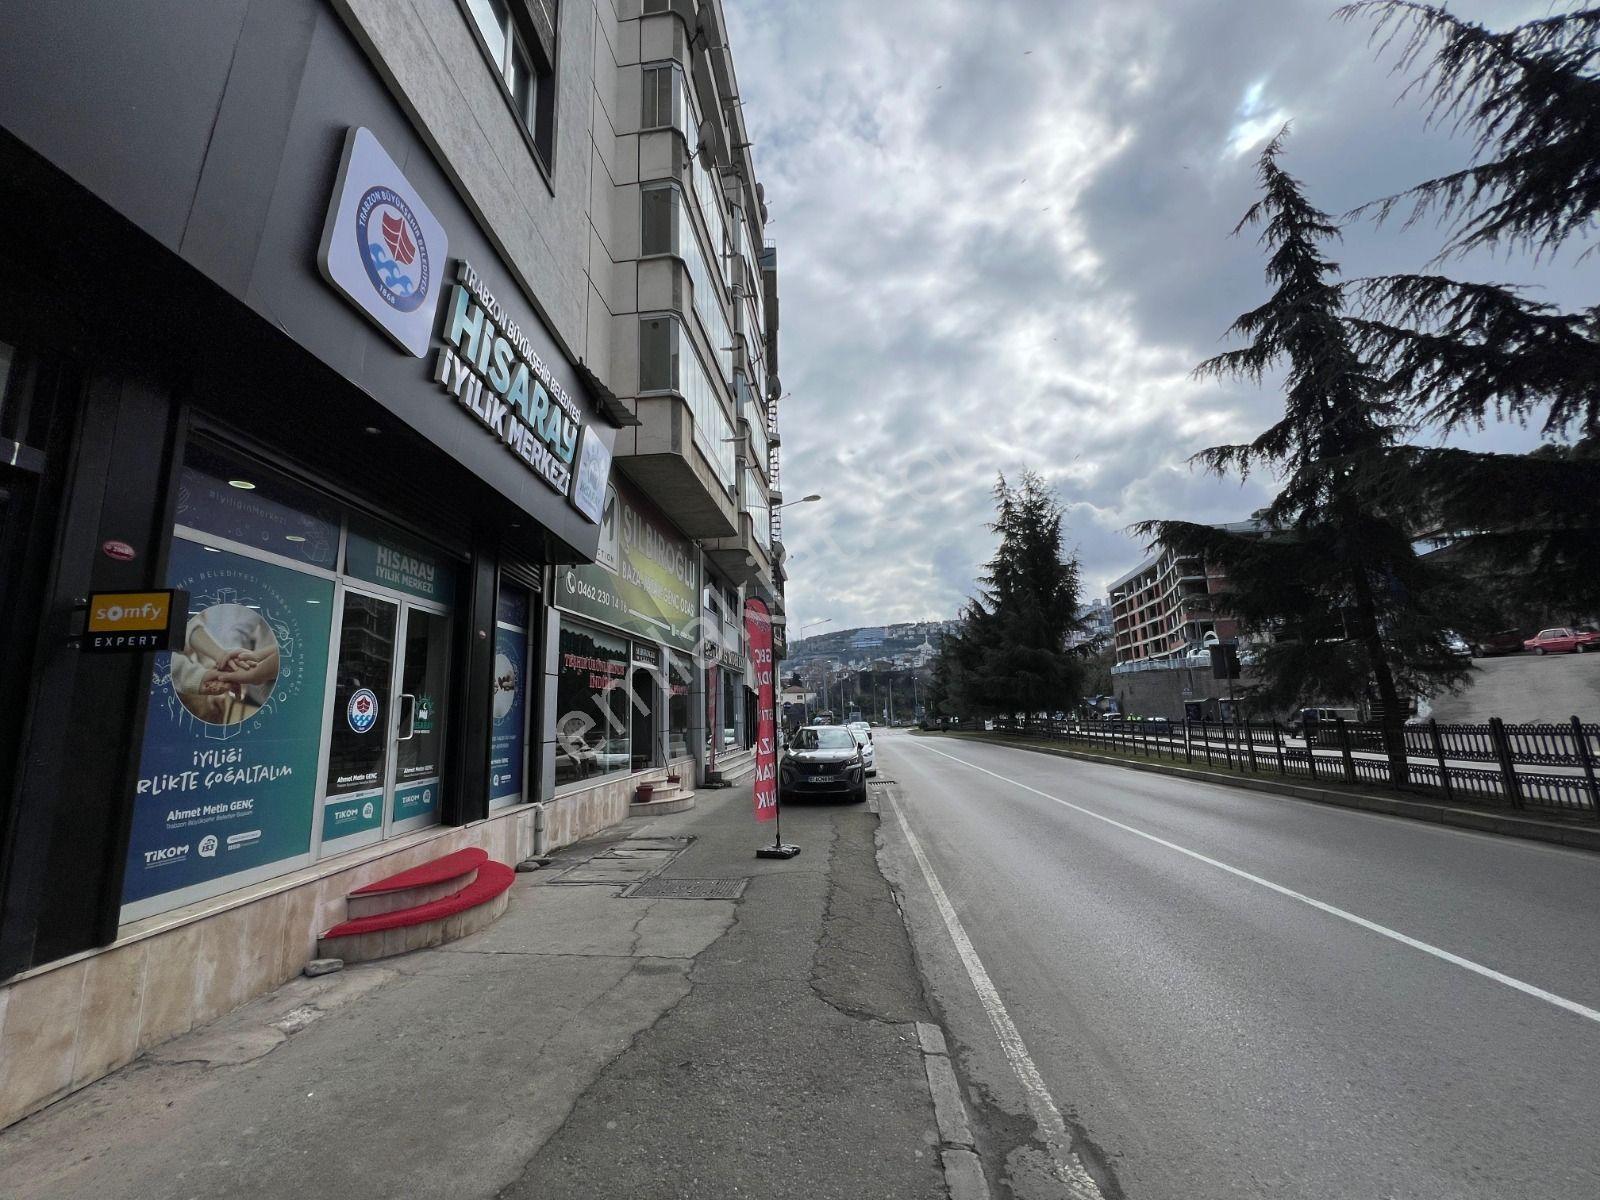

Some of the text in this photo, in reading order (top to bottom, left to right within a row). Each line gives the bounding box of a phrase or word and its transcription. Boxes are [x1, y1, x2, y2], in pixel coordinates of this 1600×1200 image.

[459, 258, 582, 425] TRABZON BÜYÜKŞEHİR BELEDİYESİ
[438, 347, 571, 498] İYİLİK MERKEZİ
[577, 580, 596, 601] 0462
[597, 589, 610, 606] 230
[96, 603, 161, 621] somfy
[94, 635, 158, 648] EXPERT
[193, 747, 243, 768] İYİLİĞİ
[203, 764, 293, 790] ÇOĞALTALIM
[166, 798, 254, 822] Ahmet Metin GENÇ
